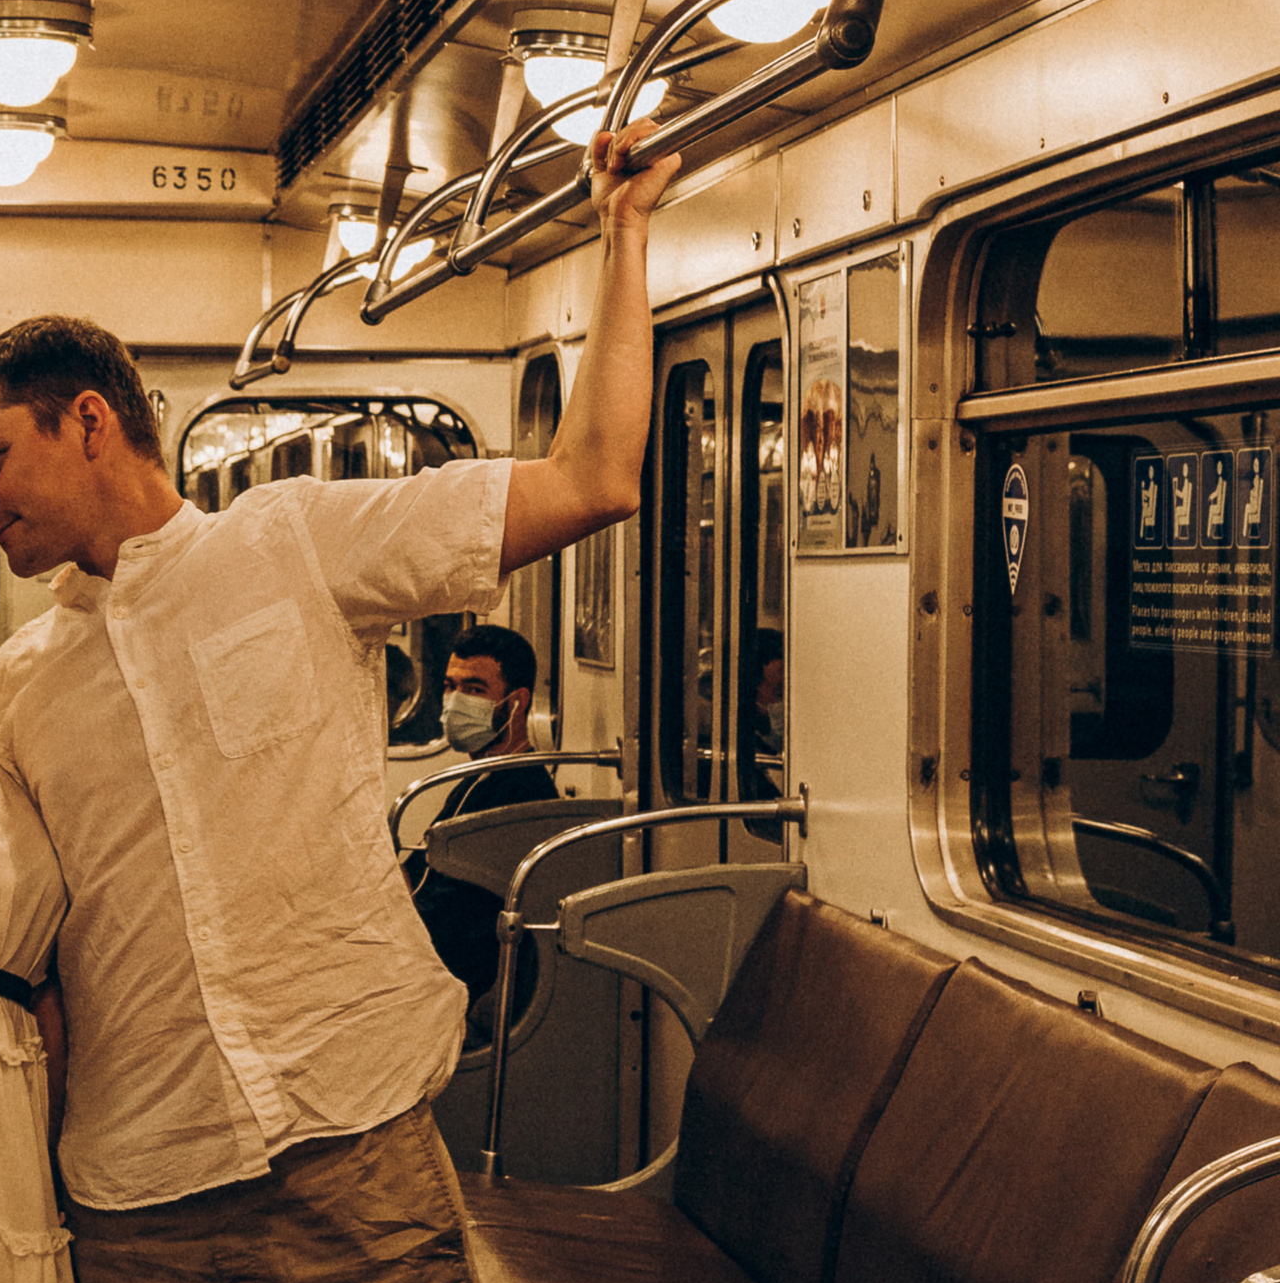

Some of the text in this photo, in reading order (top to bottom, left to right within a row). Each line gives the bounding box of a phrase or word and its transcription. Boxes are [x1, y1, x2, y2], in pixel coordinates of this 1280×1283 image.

[152, 165, 236, 191] 6350
[1132, 560, 1150, 573] Места
[1132, 605, 1150, 617] Places
[1197, 608, 1210, 620] with
[1242, 609, 1270, 623] disabled
[1177, 627, 1199, 641] people
[1200, 627, 1212, 640] and
[1214, 629, 1244, 644] pregnant
[1245, 632, 1270, 643] women
